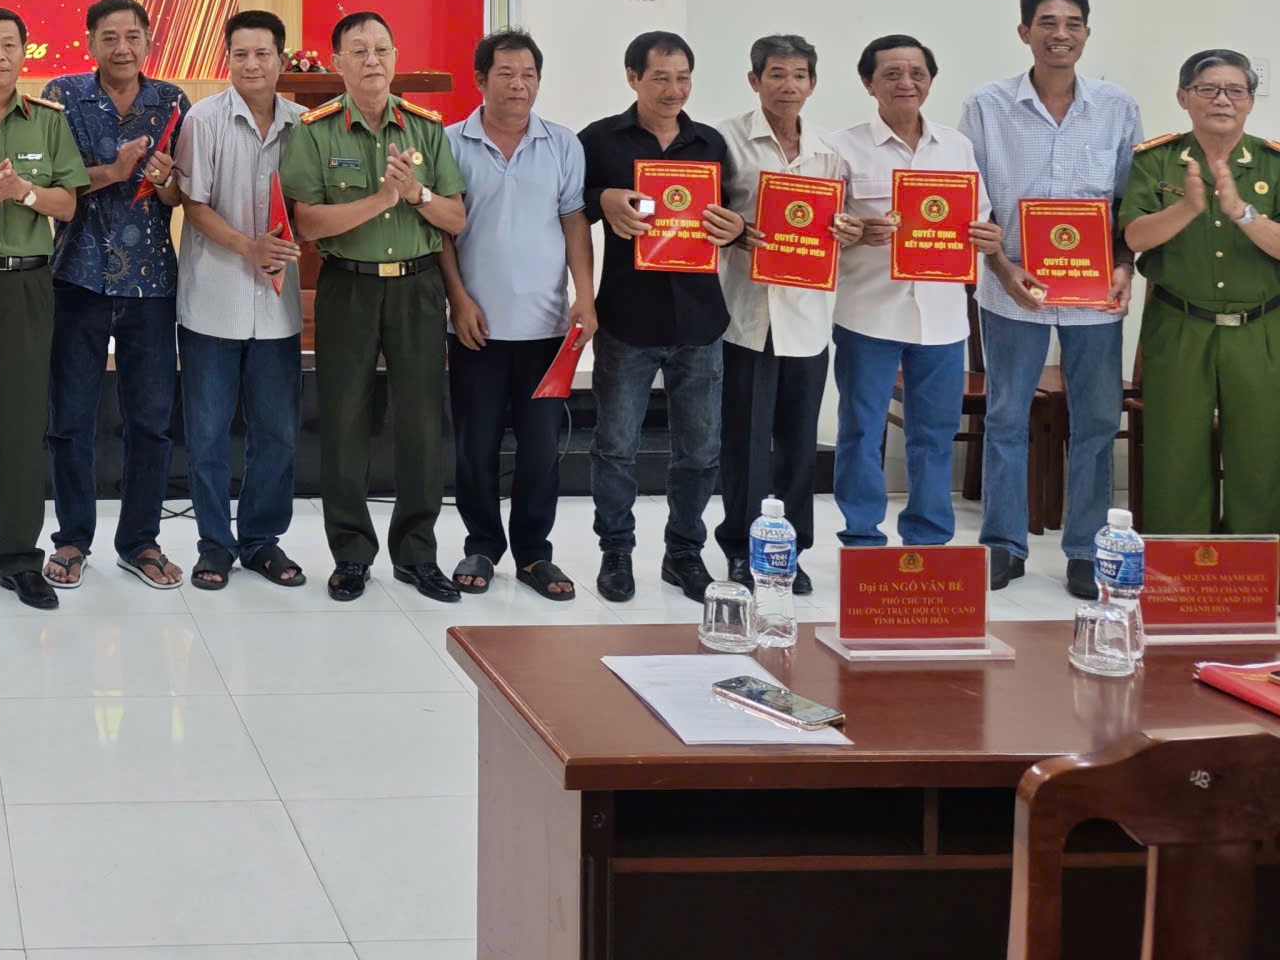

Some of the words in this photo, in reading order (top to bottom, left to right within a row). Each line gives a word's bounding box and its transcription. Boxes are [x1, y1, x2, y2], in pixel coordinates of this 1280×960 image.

[774, 233, 798, 243] QUYẾT
[912, 228, 936, 238] QUYẾT
[1044, 256, 1068, 266] QUYẾT
[858, 582, 876, 594] Đại
[891, 579, 918, 591] NGÔ
[920, 579, 945, 591] VĂN
